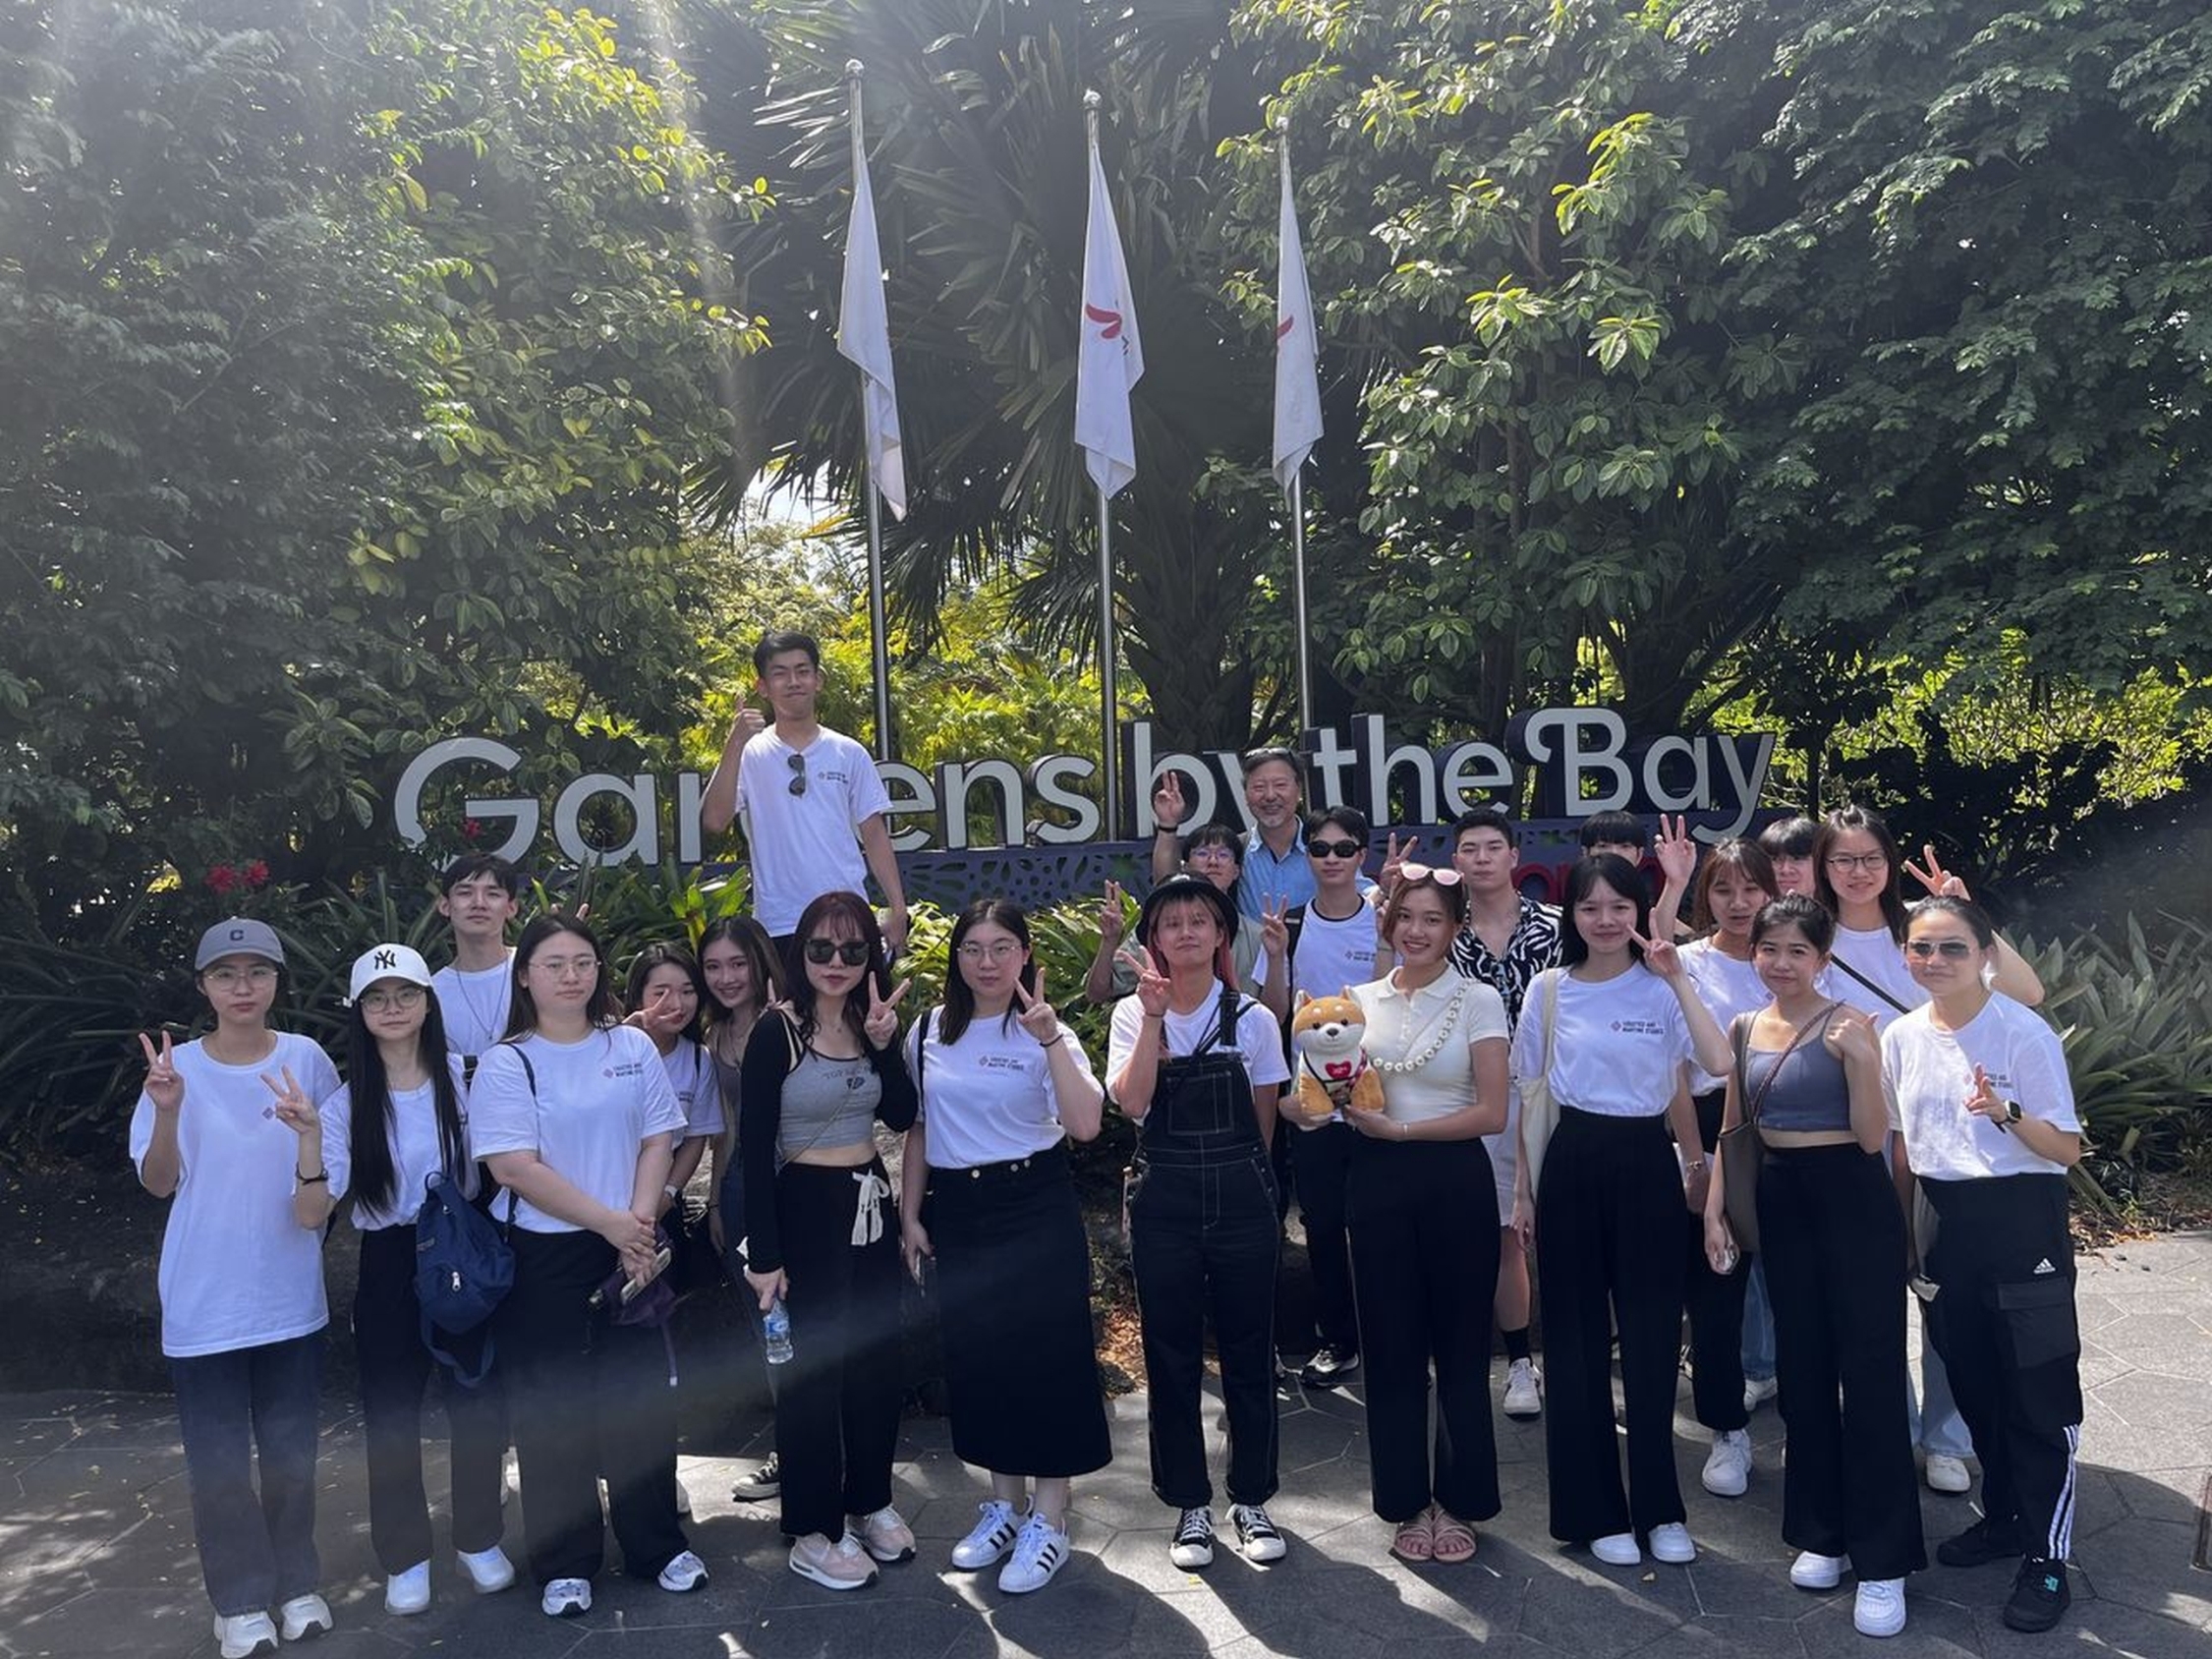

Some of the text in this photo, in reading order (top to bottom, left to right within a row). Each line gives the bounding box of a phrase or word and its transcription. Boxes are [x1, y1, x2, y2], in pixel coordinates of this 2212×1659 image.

[1313, 714, 1514, 829] the
[1524, 707, 1776, 844] Bay
[229, 930, 245, 942] C
[374, 949, 396, 970] NY
